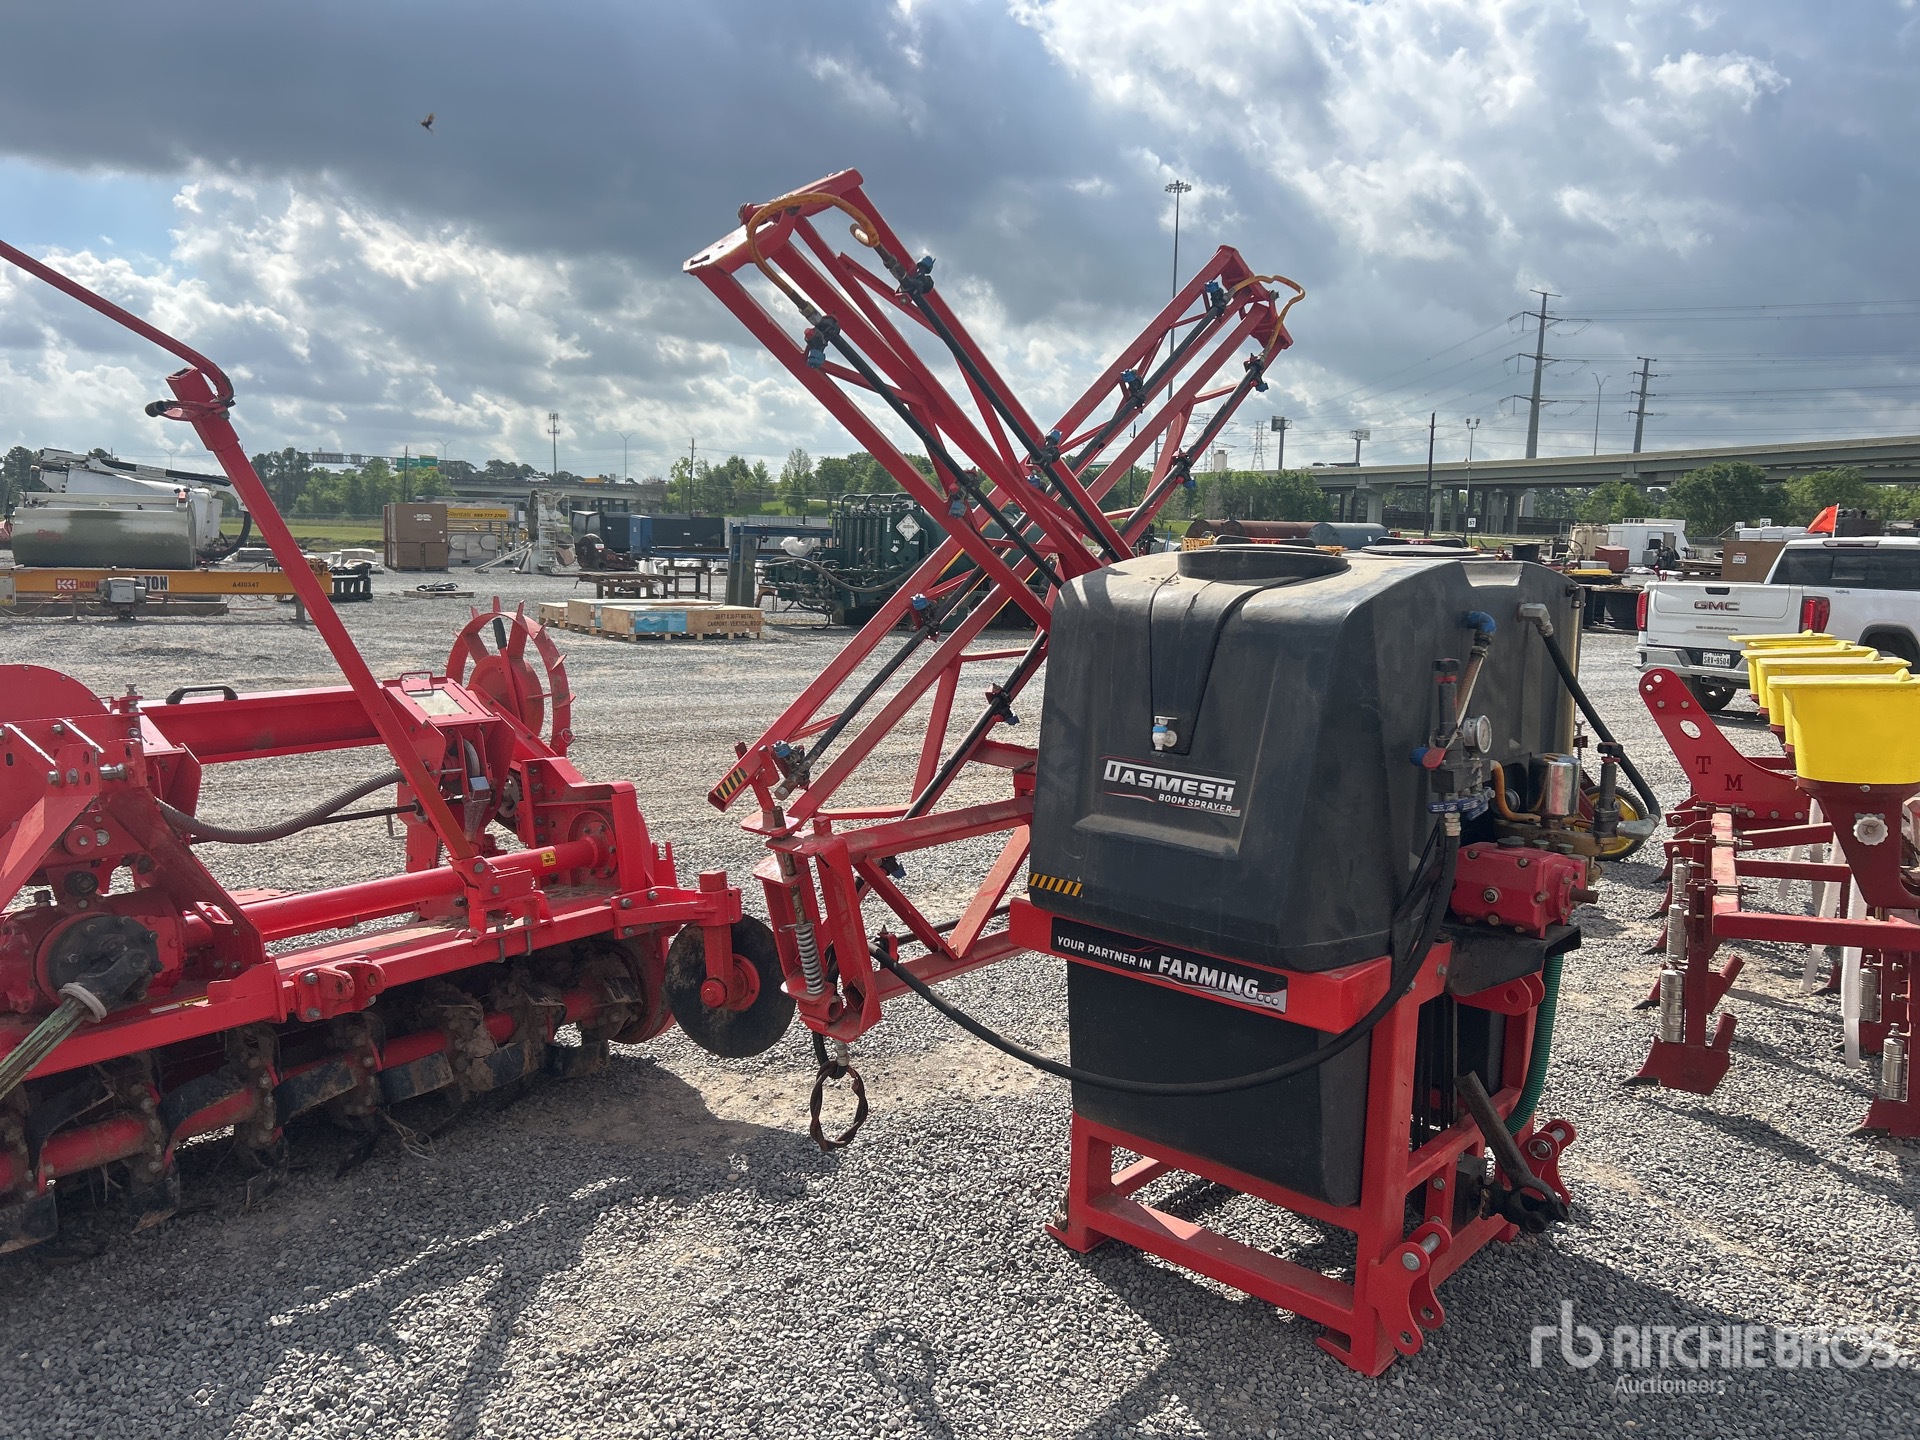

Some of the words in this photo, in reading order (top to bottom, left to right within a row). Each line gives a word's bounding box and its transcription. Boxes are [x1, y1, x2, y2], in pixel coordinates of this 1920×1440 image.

[144, 576, 168, 590] TON
[1693, 600, 1740, 611] GMC
[1103, 760, 1236, 801] DASMESH
[1158, 793, 1186, 805] BOOM
[1187, 799, 1233, 813] SPRAYER
[1057, 936, 1085, 952] YOUR
[1087, 943, 1136, 966] PARTNER
[1139, 957, 1152, 970] IN
